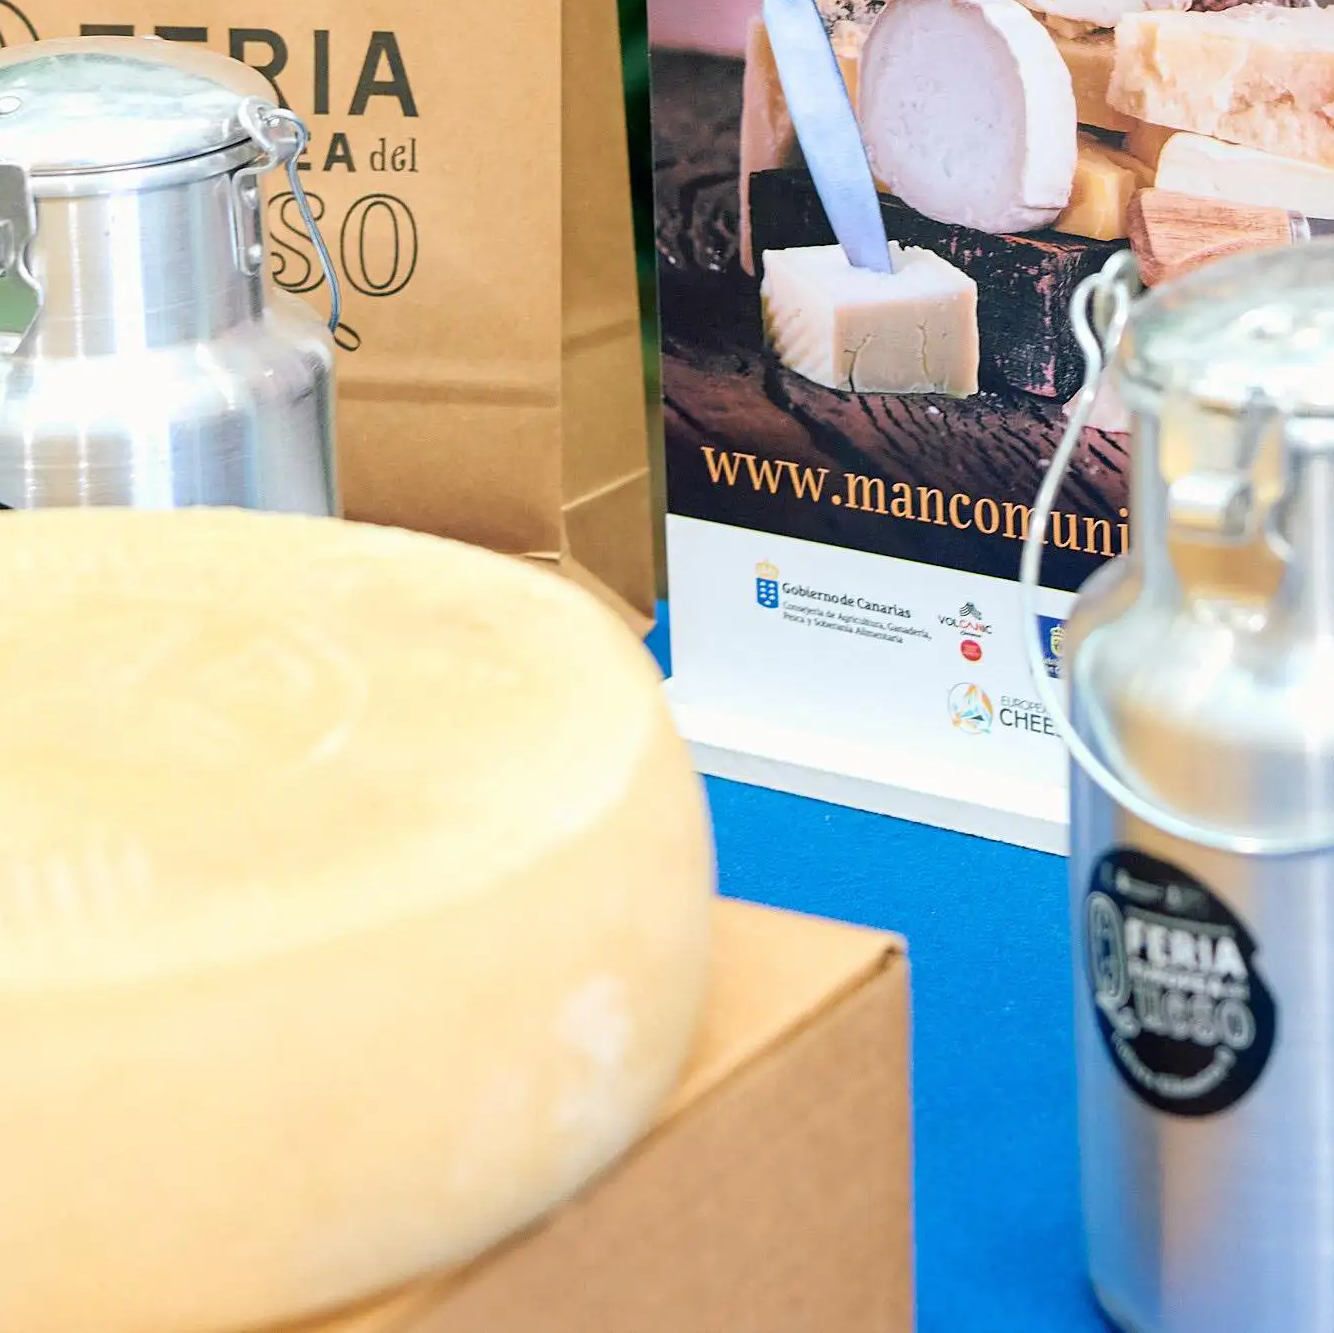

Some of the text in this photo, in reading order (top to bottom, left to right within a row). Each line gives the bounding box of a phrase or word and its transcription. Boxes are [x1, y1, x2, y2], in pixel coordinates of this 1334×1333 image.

[79, 24, 420, 118] RIA
[370, 136, 419, 174] del
[701, 445, 1129, 559] www.mancomuni
[782, 582, 912, 619] Gobierno de Canarias
